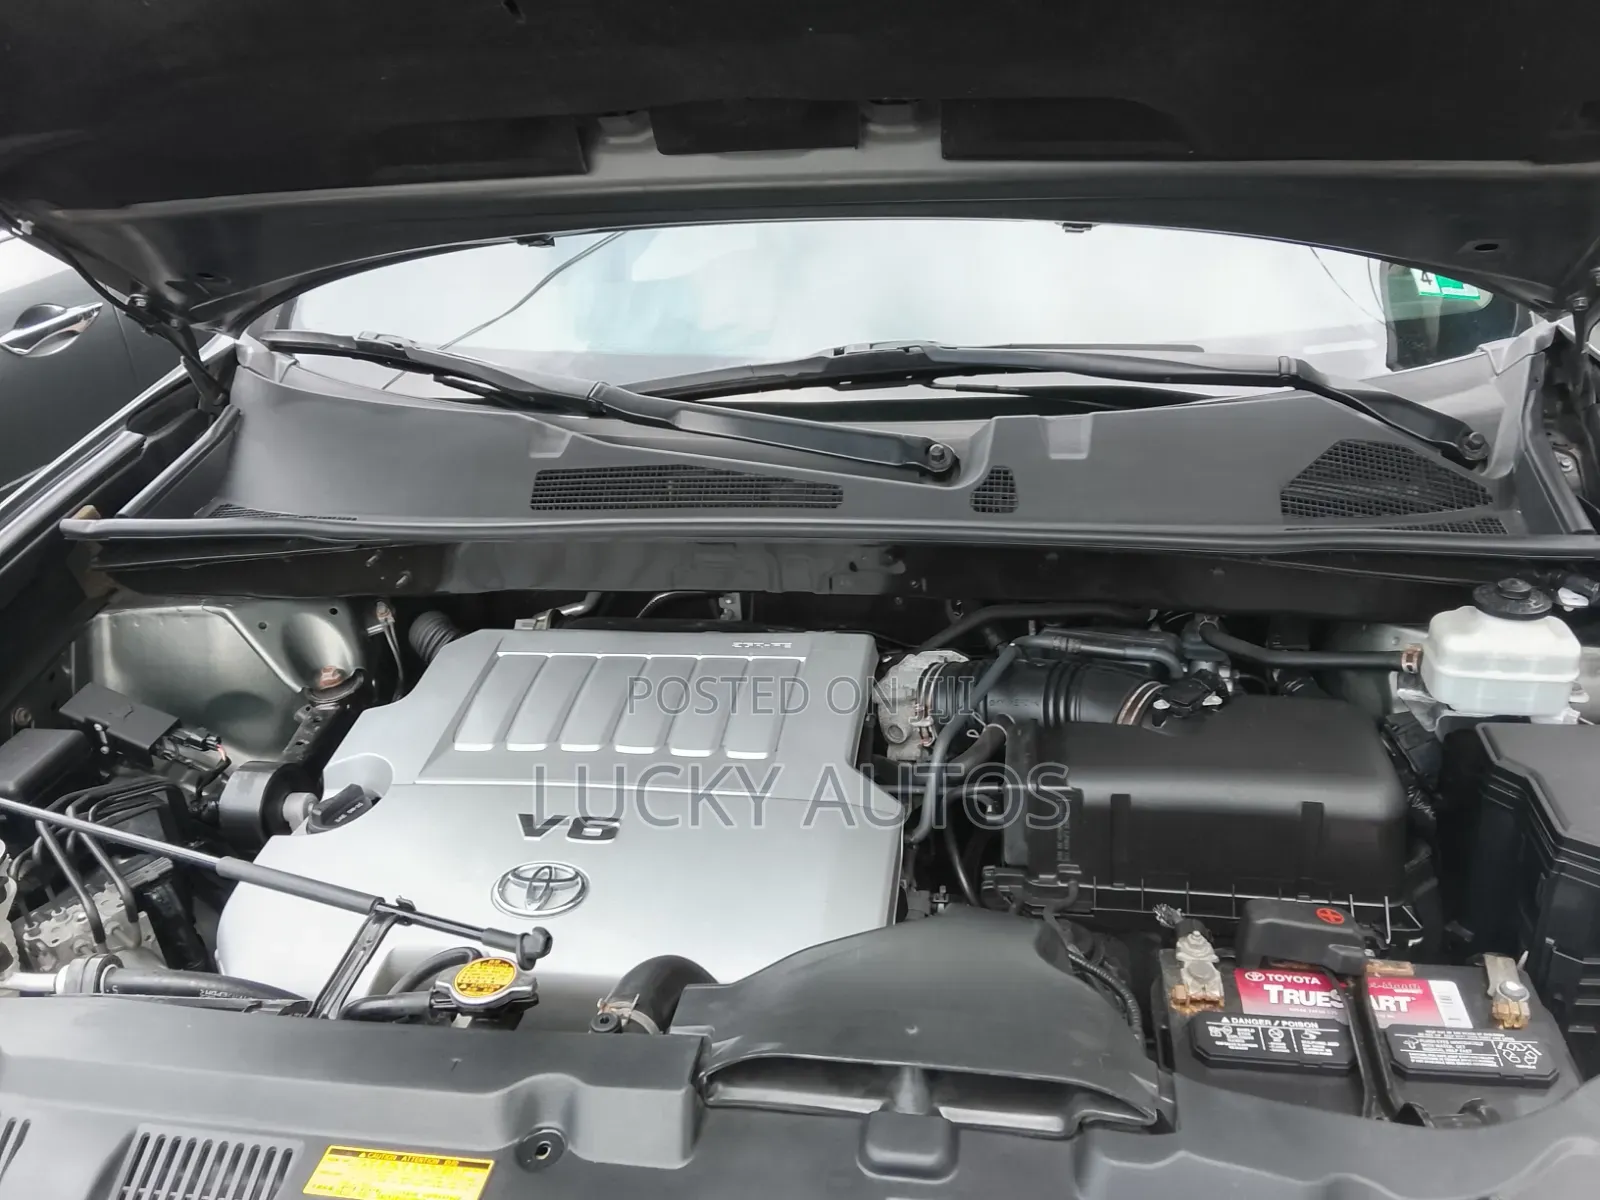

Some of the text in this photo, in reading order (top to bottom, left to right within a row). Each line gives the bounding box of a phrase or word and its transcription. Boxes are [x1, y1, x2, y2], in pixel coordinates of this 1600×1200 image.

[518, 814, 624, 842] V6
[1266, 973, 1321, 985] TOYOTA
[1231, 1017, 1272, 1026] DANGER
[1281, 1020, 1319, 1029] POISON
[367, 1152, 397, 1161] CAUTION
[401, 1155, 439, 1165] ATTENTION
